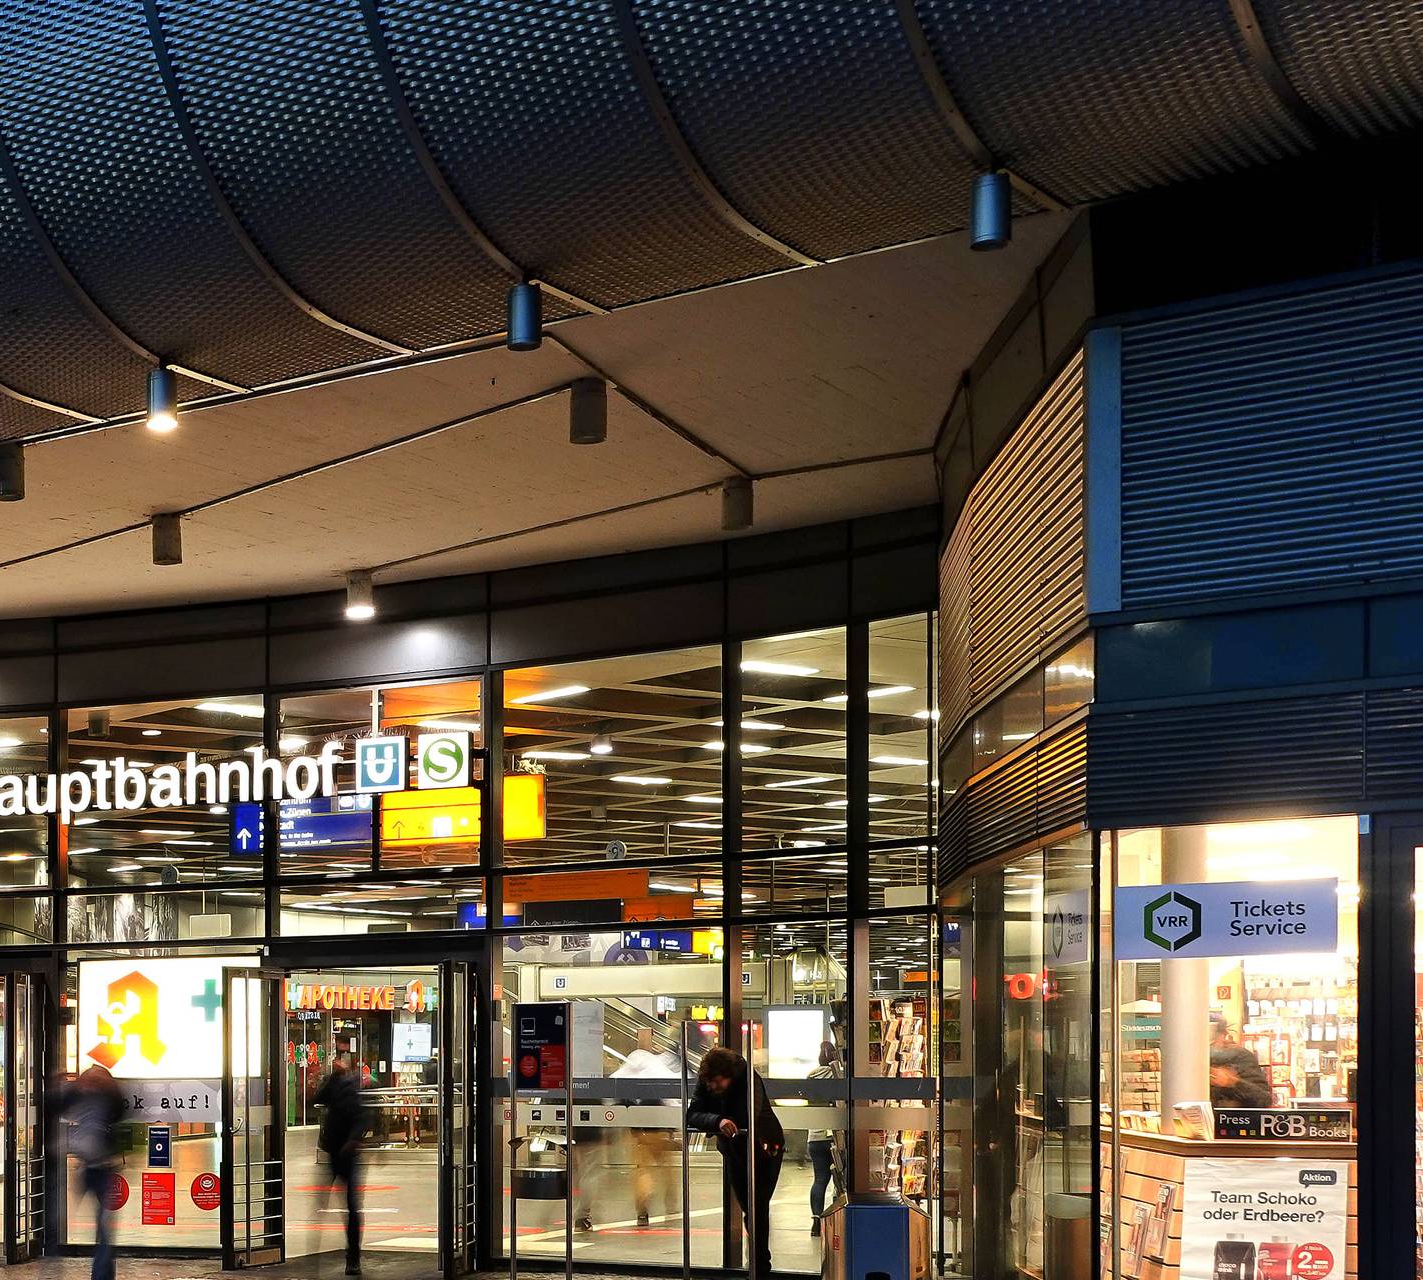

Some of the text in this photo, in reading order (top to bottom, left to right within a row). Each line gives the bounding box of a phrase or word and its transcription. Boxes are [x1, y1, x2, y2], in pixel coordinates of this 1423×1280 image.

[1157, 899, 1306, 928] VRR Tickets
[1230, 919, 1306, 937] Service
[299, 985, 395, 1010] APOTHEKE
[160, 1094, 210, 1110] auf!
[1219, 1113, 1250, 1125] Press
[1309, 1126, 1348, 1138] Books
[1302, 1172, 1332, 1183] Aktion
[1211, 1190, 1318, 1206] Team Schoko
[1203, 1208, 1325, 1223] oder Erdbeere?
